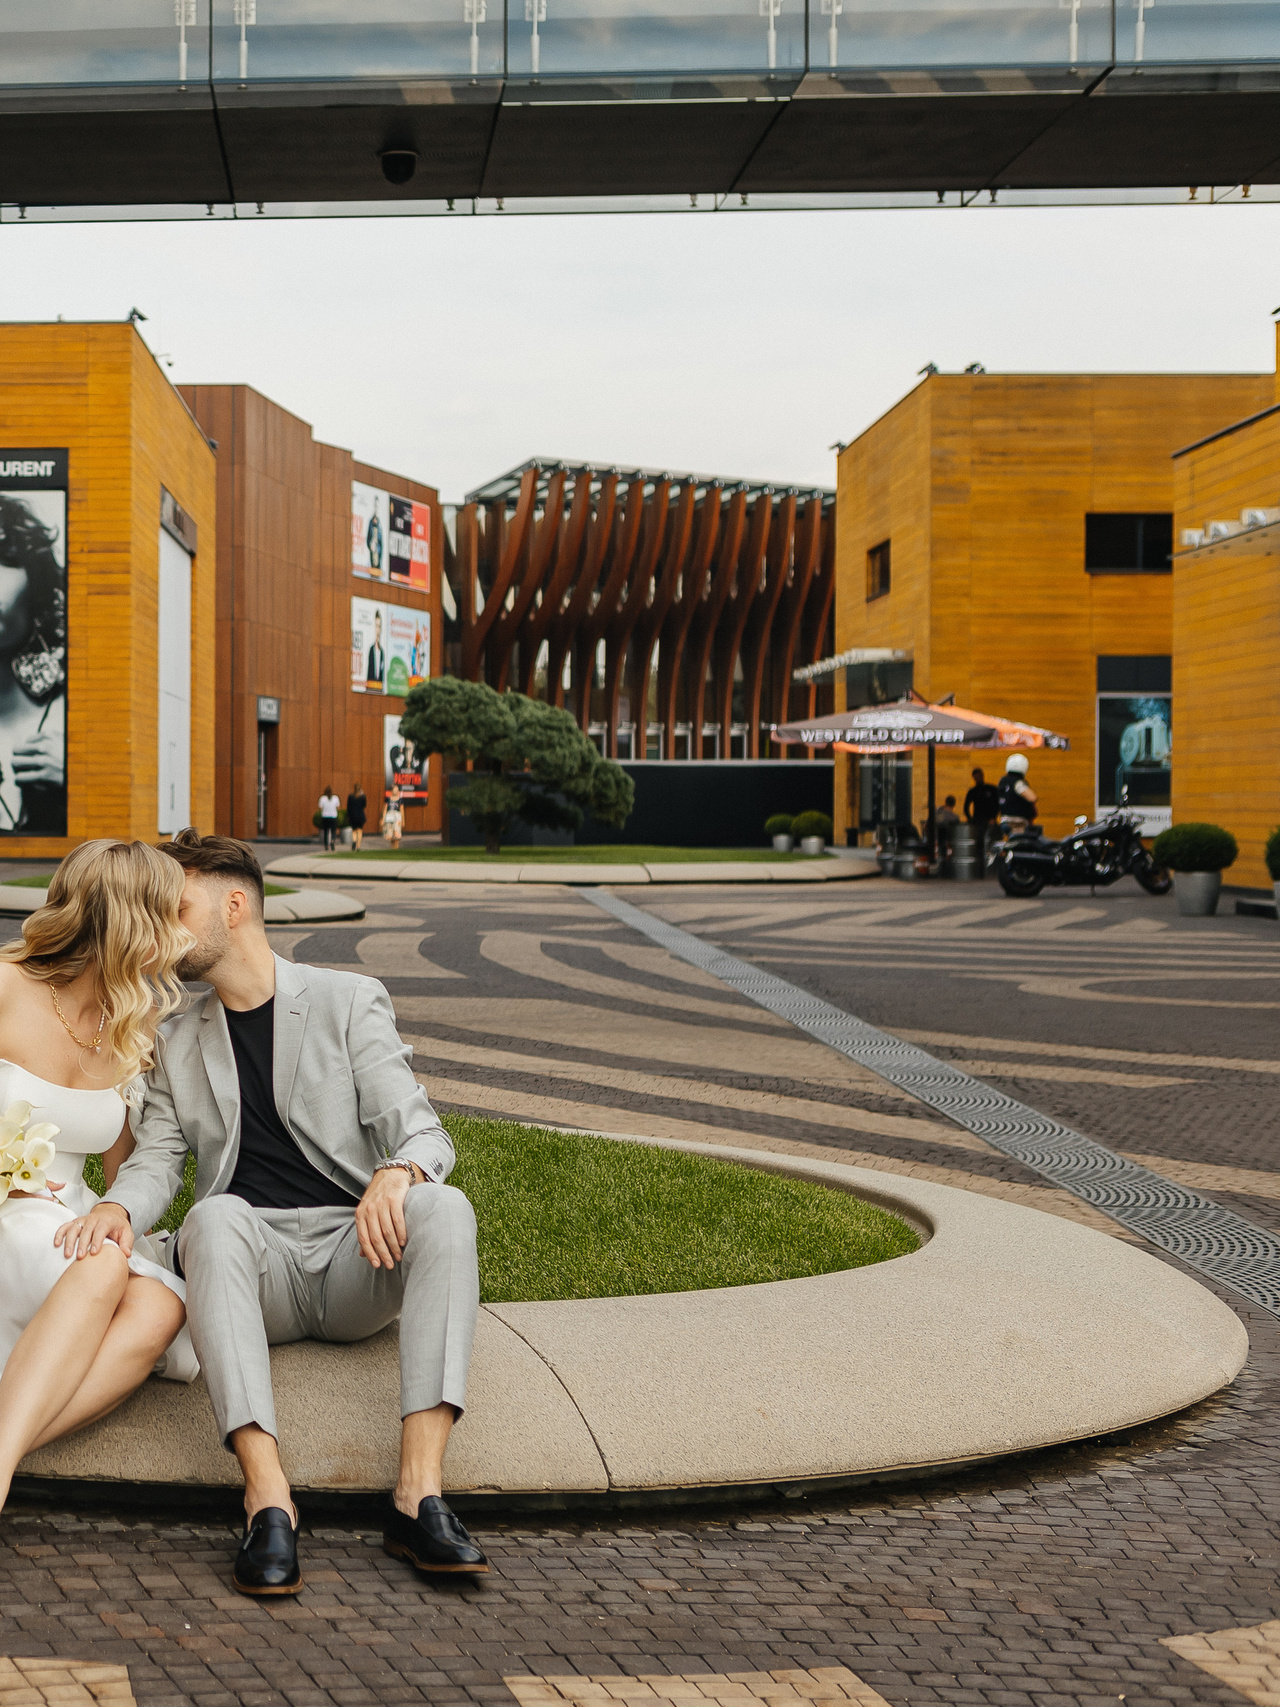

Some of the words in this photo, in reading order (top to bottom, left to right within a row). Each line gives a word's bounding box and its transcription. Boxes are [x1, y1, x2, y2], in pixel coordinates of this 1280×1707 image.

[800, 729, 843, 743] WEST
[845, 728, 889, 743] FIELD
[891, 728, 965, 743] CHAPTER
